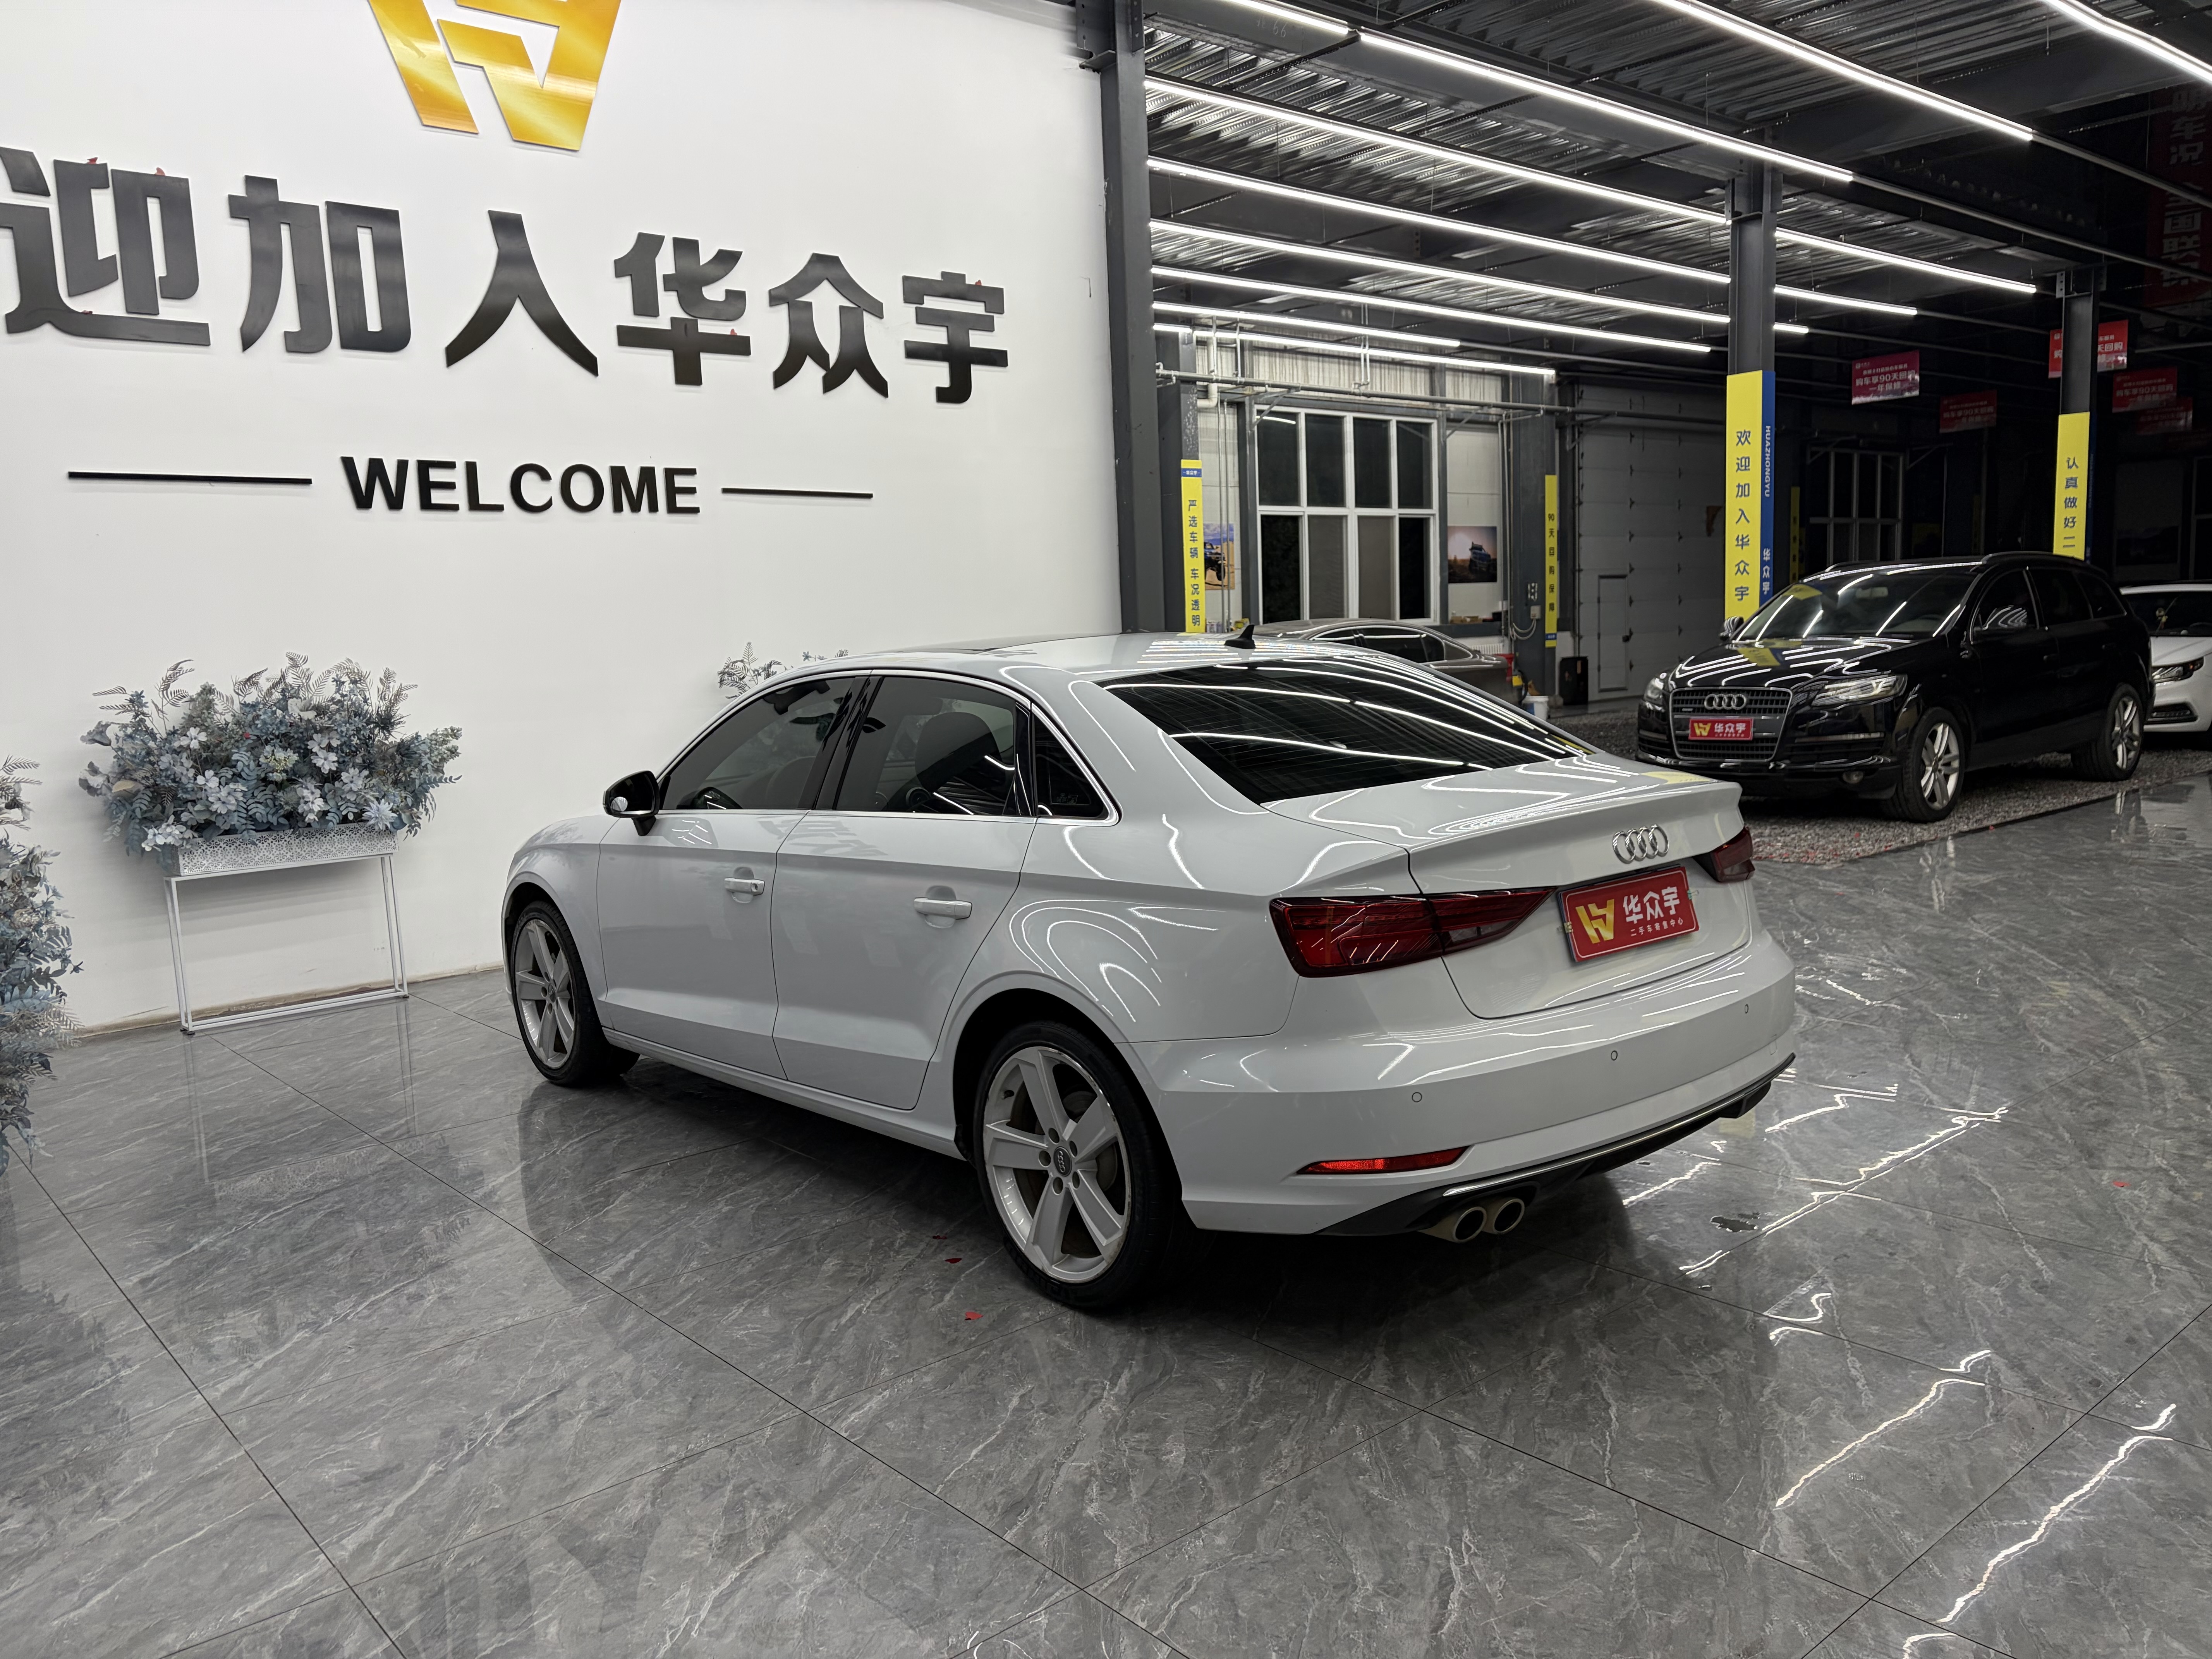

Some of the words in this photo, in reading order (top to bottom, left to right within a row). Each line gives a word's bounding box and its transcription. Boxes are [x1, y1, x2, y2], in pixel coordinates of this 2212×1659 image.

[0, 147, 1008, 404] 迎加入华众宇
[341, 455, 700, 514] WELCOME
[2063, 457, 2079, 549] 认真做好二
[1735, 429, 1751, 601] 欢迎加入华众宇
[1190, 568, 1200, 626] 车况透明
[1762, 548, 1771, 595] 华众宇
[1714, 723, 1746, 733] 华众宇
[1623, 886, 1680, 924] 华众宇
[1630, 917, 1683, 937] 二手车寄售中心
